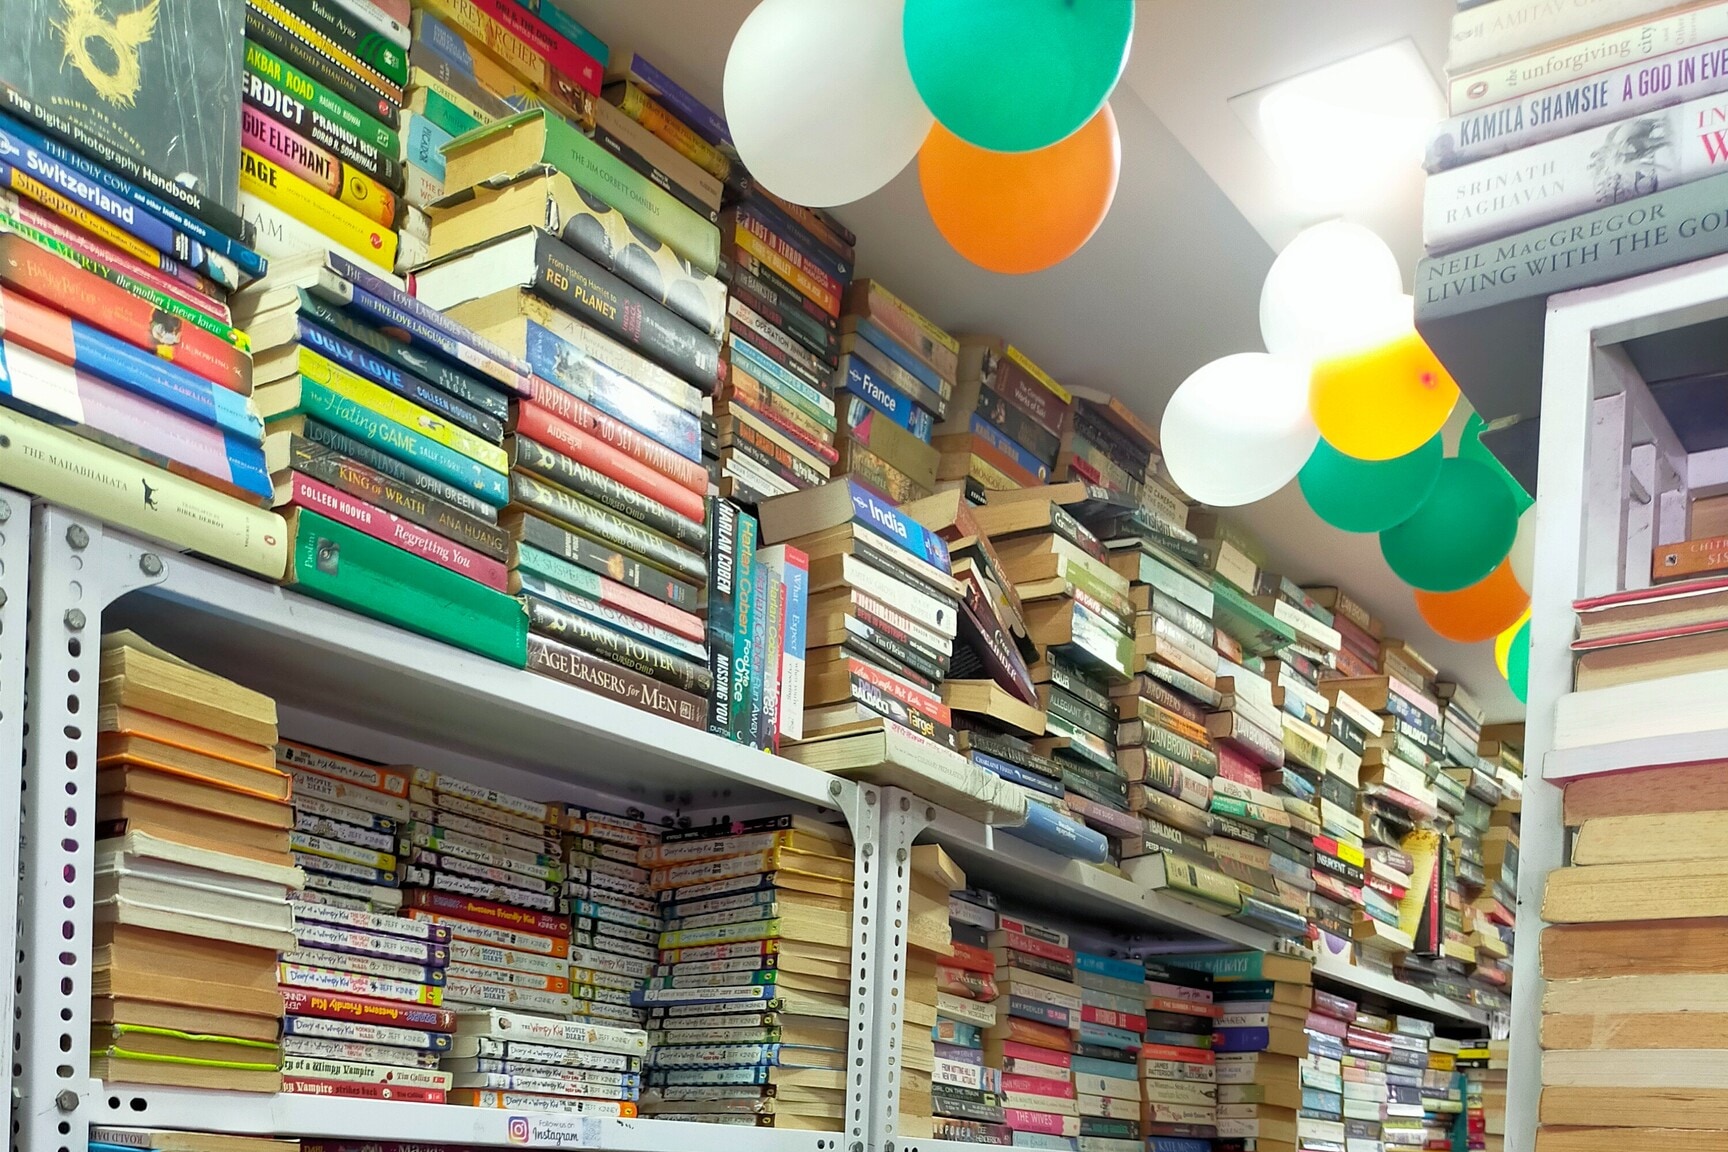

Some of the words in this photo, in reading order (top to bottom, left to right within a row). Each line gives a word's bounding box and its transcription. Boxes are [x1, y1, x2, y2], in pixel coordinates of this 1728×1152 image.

[248, 48, 281, 82] AKBAR
[286, 69, 314, 100] ROAD
[312, 111, 358, 147] PRANNOY
[361, 138, 378, 160] ROY
[1460, 105, 1523, 147] KAMILA
[1530, 80, 1608, 126] SHAMSIE
[7, 89, 31, 112] The
[35, 102, 70, 135] Digital
[73, 124, 140, 177] Photography
[142, 164, 200, 209] Handbook
[44, 138, 68, 160] THE
[71, 152, 101, 178] HOLY
[103, 172, 131, 195] COW
[269, 127, 332, 180] ELEPHANT
[16, 170, 89, 222] Singapore
[27, 150, 133, 224] Switzerland
[571, 149, 585, 165] THE
[586, 158, 599, 176] JIM
[599, 166, 630, 197] CORBETT
[629, 186, 660, 217] OMNIBUS
[1427, 266, 1516, 303] LIVING
[1525, 243, 1599, 277] WITH
[1610, 227, 1669, 257] THE
[546, 269, 568, 291] RED
[574, 286, 616, 320] PLANET
[309, 329, 353, 361] UGLY
[360, 356, 404, 387] LOVE
[862, 375, 897, 412] France
[324, 397, 377, 438] Hating
[379, 425, 417, 454] GAME
[22, 446, 44, 461] THE
[49, 456, 127, 491] MAHABHARATA
[339, 467, 369, 489] KING
[385, 488, 425, 515] WRATH
[301, 485, 338, 508] COLLEEN
[340, 501, 371, 524] HOOVER
[717, 504, 733, 550] HARLAN
[869, 498, 907, 539] India
[394, 524, 449, 560] Regretting
[452, 550, 470, 568] You
[717, 551, 733, 594] COBEN
[538, 645, 568, 673] AGE
[569, 654, 625, 694] ERASERS
[626, 685, 639, 697] for
[640, 683, 677, 714] MEN
[716, 653, 729, 703] MISSING
[715, 703, 728, 725] YOU
[907, 708, 935, 737] Target
[1151, 731, 1166, 750] DAN
[1167, 738, 1192, 762] BROWN
[1150, 755, 1174, 792] KING
[565, 1026, 585, 1034] MOVIE
[566, 1033, 585, 1041] DIARY
[313, 1061, 340, 1075] Wimpy
[343, 1064, 374, 1076] Vampire
[532, 1127, 579, 1145] Instagram
[1016, 1111, 1030, 1122] THE
[1032, 1113, 1052, 1126] WIVES
